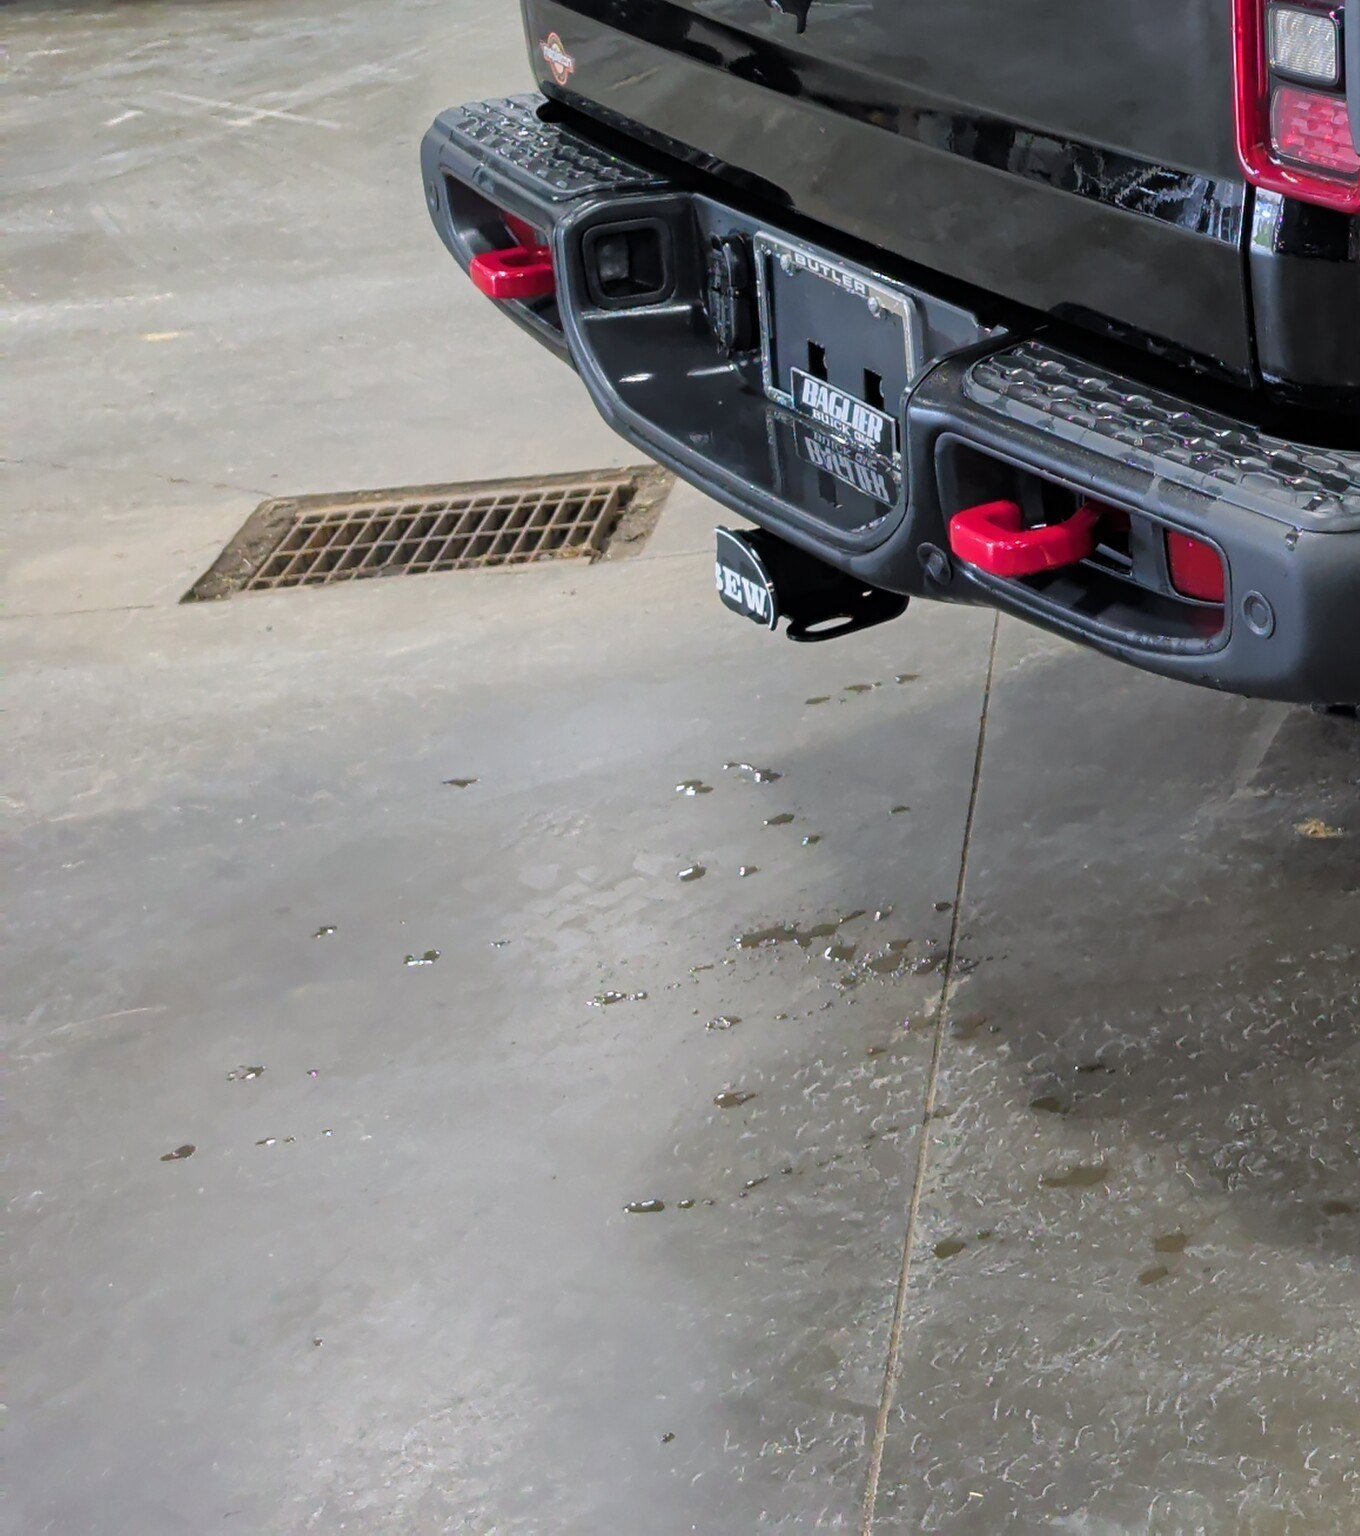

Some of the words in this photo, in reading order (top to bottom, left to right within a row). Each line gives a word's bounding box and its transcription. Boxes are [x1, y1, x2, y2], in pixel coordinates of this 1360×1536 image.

[794, 251, 867, 295] BUTLER
[802, 377, 884, 444] BAGLIER
[812, 408, 851, 438] BUICK
